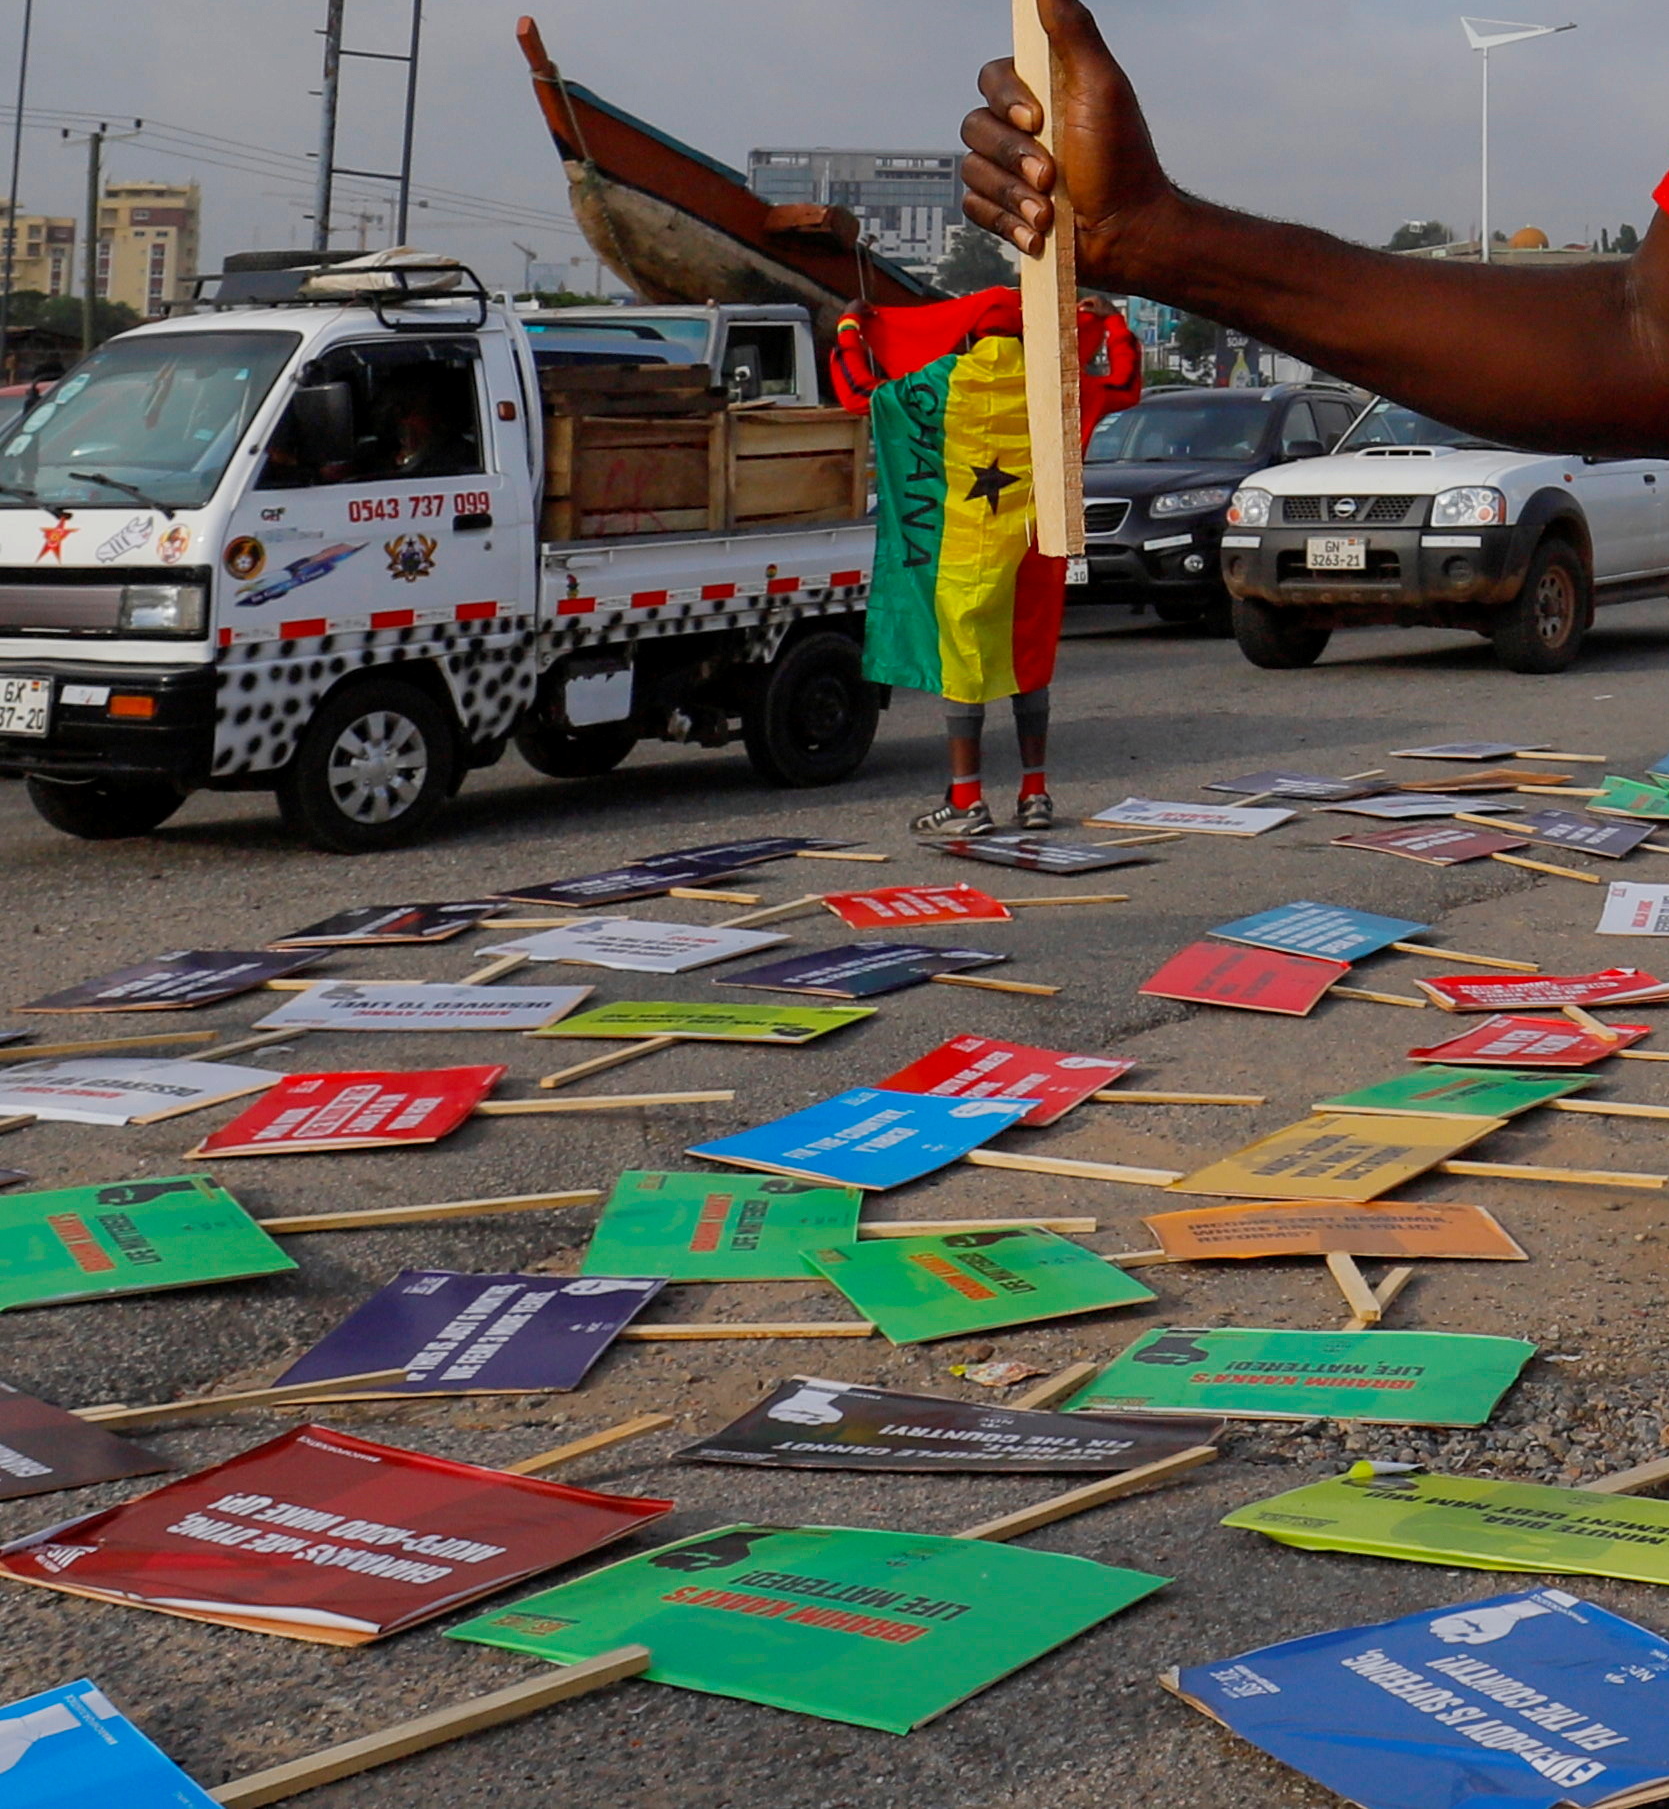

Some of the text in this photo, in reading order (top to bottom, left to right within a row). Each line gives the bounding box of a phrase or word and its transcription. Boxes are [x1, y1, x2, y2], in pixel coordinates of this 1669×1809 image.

[1226, 337, 1248, 346] SOAP
[902, 383, 940, 567] GHANA
[348, 491, 490, 522] 0543 737 099
[1325, 540, 1339, 552] GN
[1311, 554, 1359, 566] 3263-21
[4, 681, 26, 703] GX
[328, 1000, 393, 1008] LIVE!
[1370, 1222, 1440, 1231] POLICE
[1225, 1360, 1424, 1375] LIFE MATTERED!
[1190, 1372, 1416, 1388] IBRAHIM KAAKA'S
[869, 1424, 1137, 1448] FIX THE COUNTRY!
[754, 1440, 900, 1455] CANNOT
[890, 1448, 1008, 1459] PEOPLE
[975, 1443, 1063, 1453] RENT,
[1423, 1495, 1491, 1512] NAM
[1491, 1504, 1568, 1522] DEBT
[163, 1508, 267, 1548] DYING,
[206, 1487, 507, 1566] AKUFO-ADDO WAKE UP!
[1475, 1512, 1551, 1531] BIAA,
[239, 1529, 314, 1558] ARE
[1551, 1522, 1668, 1547] MINUTE
[727, 1567, 974, 1622] LIFE MATTERED!
[658, 1583, 932, 1644] IBRAHIM KAAKA'S
[1341, 1646, 1606, 1788] EVERYBODY IS SUFFERING,
[1522, 1687, 1588, 1732] THE
[1569, 1714, 1629, 1752] FIX
